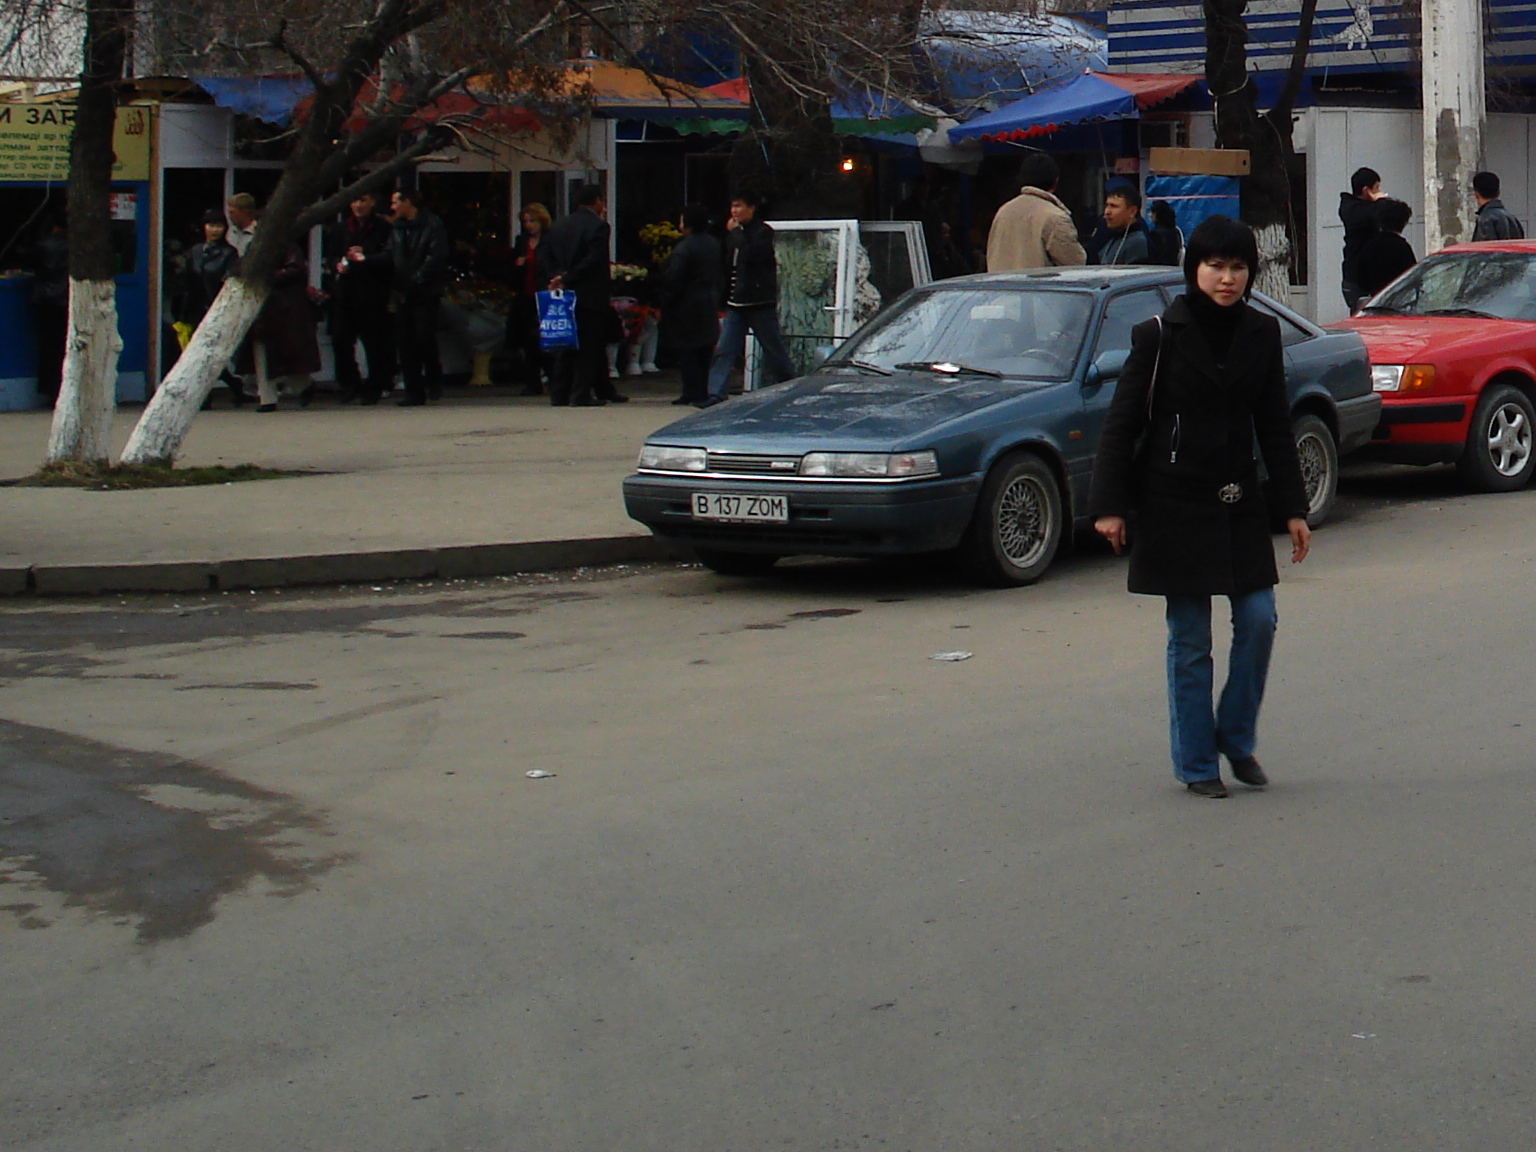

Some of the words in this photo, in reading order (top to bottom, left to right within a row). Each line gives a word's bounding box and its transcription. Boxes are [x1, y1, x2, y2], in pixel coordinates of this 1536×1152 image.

[697, 496, 708, 514] B
[714, 497, 740, 515] 137
[746, 497, 783, 517] ZOM
